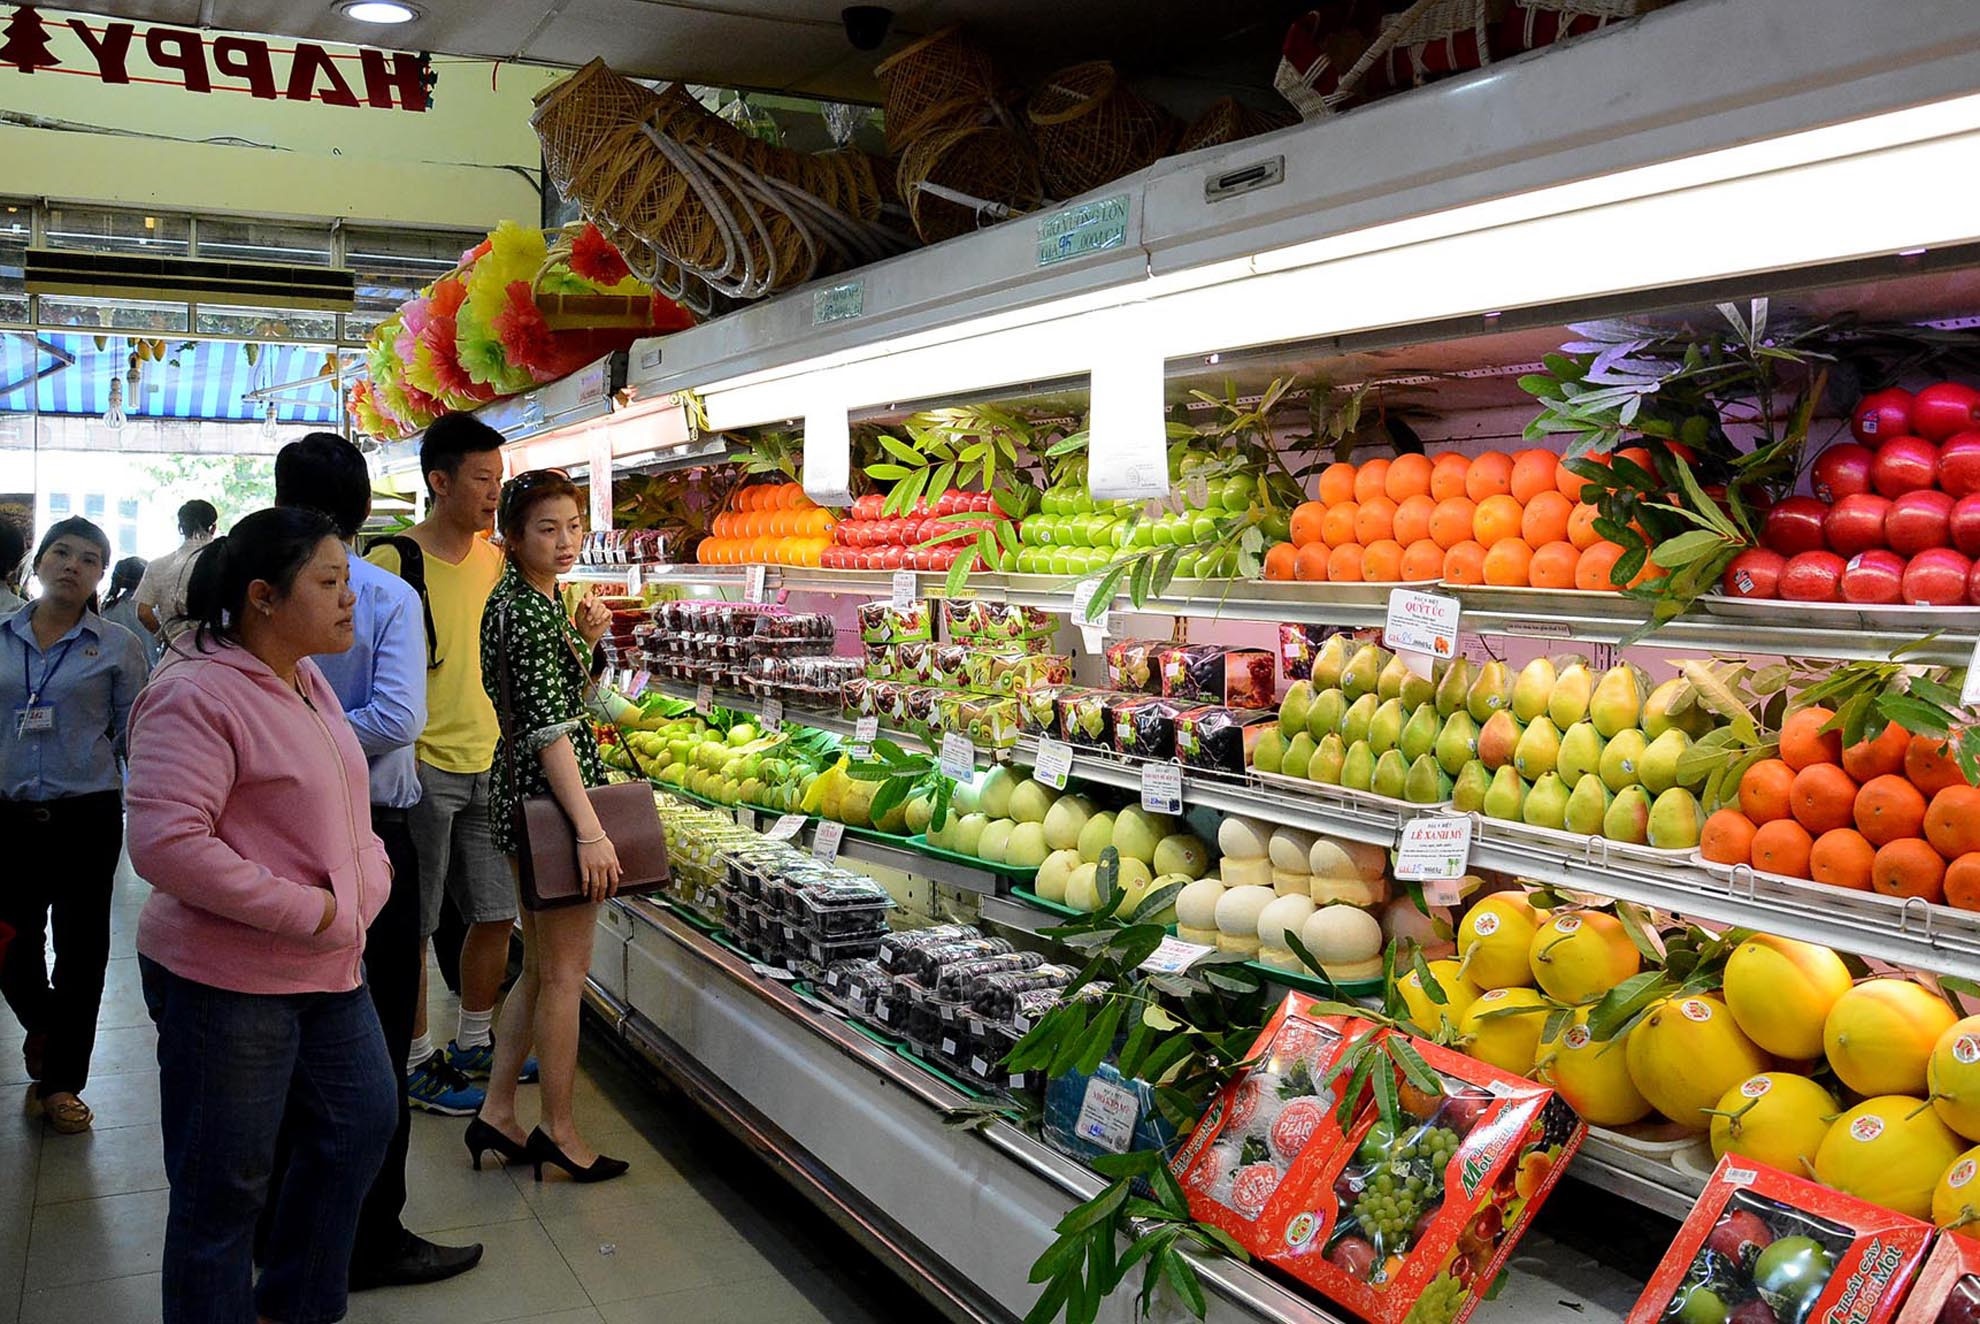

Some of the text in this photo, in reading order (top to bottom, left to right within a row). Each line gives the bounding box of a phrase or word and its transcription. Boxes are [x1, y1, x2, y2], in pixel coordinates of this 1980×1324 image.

[1278, 1120, 1313, 1137] PEAR
[1239, 1172, 1274, 1201] PEAR
[1836, 1237, 1881, 1313] TRÁI CÂY
